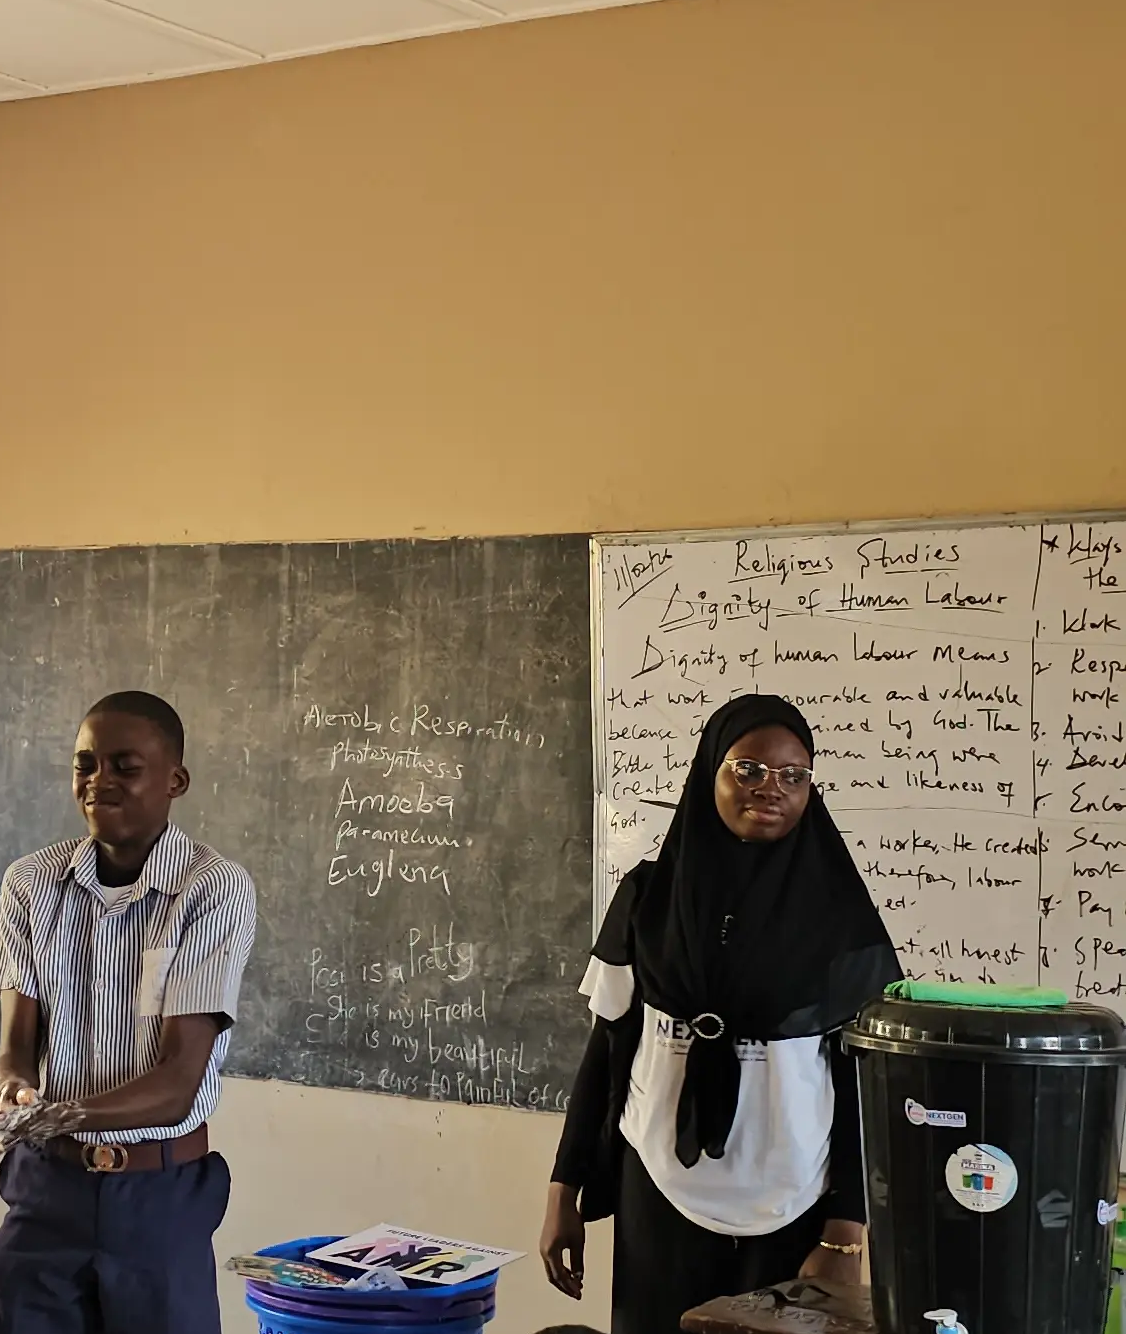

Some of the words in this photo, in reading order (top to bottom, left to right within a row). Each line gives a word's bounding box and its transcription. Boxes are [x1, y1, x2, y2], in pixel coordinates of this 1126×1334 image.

[734, 540, 834, 585] Religious
[856, 538, 961, 579] Studies
[1082, 566, 1119, 591] the
[659, 583, 771, 631] Dignity
[797, 588, 821, 617] of
[840, 582, 909, 610] Human
[925, 581, 1008, 607] Labour
[631, 635, 728, 680] Dignity
[739, 648, 764, 678] of
[774, 639, 839, 663] human
[607, 687, 655, 709] that
[668, 689, 714, 706] work
[885, 685, 930, 703] and
[938, 680, 1023, 707] valuable
[304, 704, 401, 735] Aerobic
[410, 703, 545, 749] Respiration
[608, 719, 678, 741] because
[888, 710, 912, 739] by
[977, 708, 1020, 732] The
[812, 747, 866, 760] uman
[881, 740, 939, 777] being
[952, 746, 1001, 764] were
[334, 777, 455, 820] Amoeba
[612, 775, 686, 801] create
[850, 775, 890, 789] and
[906, 770, 984, 794] likeness
[997, 781, 1015, 808] of
[328, 848, 451, 897] Euglena
[968, 866, 1022, 888] labour
[1077, 890, 1113, 928] Pay
[929, 939, 954, 959] all
[926, 1111, 964, 1122] NEXTGEN
